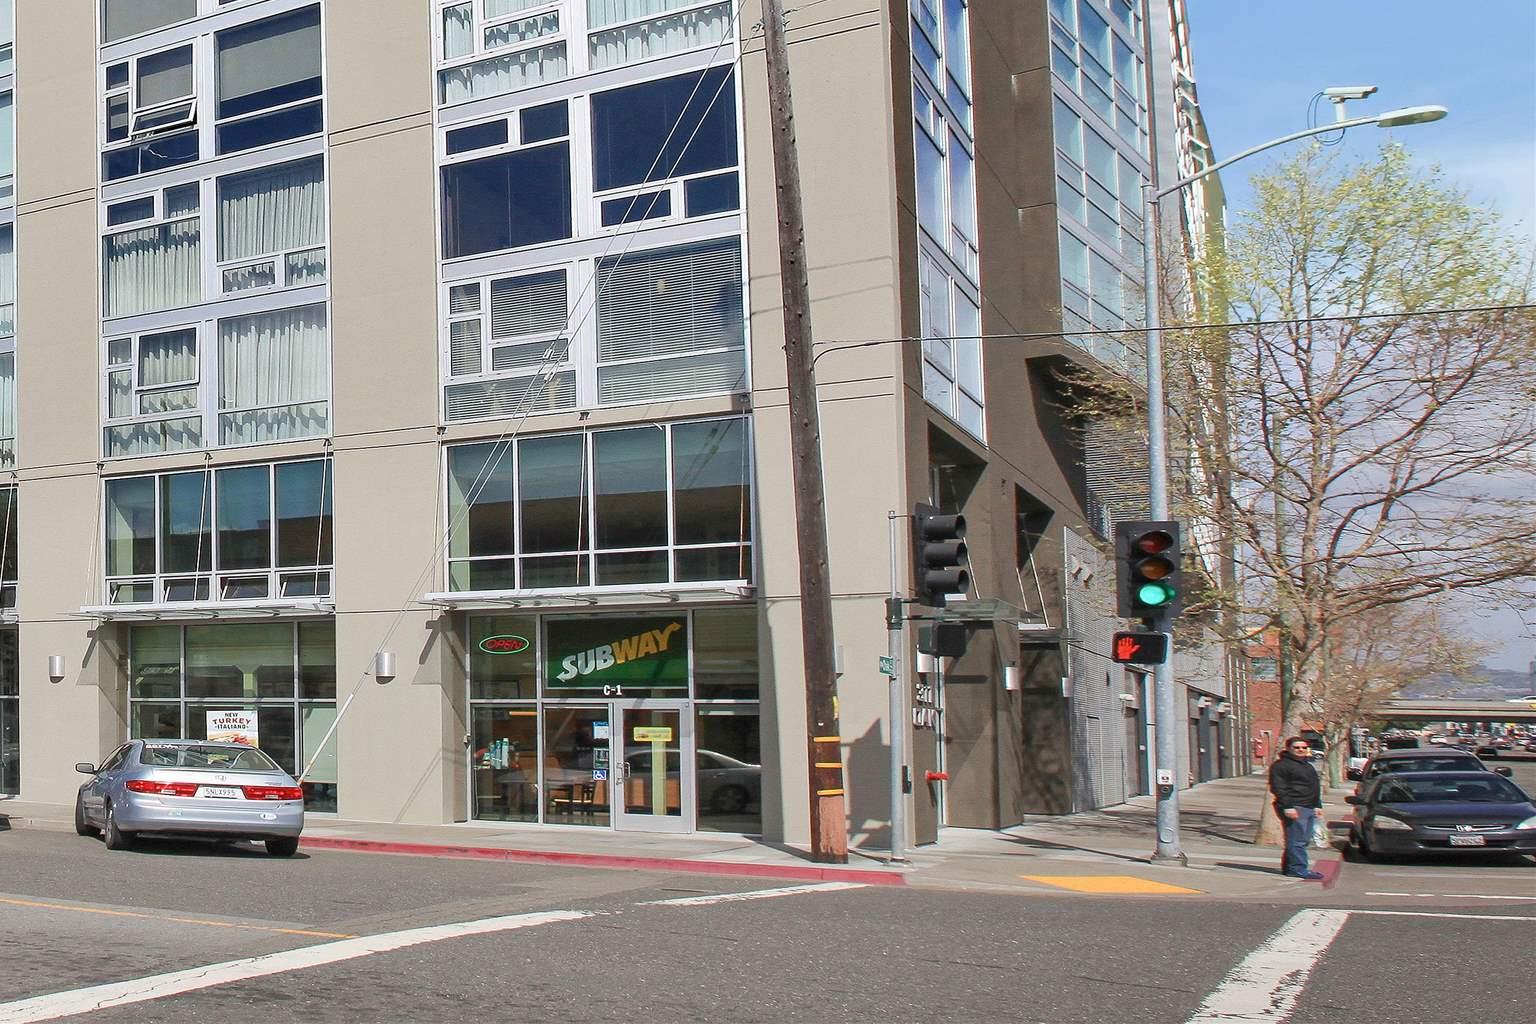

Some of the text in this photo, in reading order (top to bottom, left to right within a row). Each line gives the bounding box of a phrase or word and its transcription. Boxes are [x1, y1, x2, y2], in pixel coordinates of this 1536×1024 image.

[485, 638, 523, 650] OPEN
[556, 621, 682, 683] SUBWAY
[603, 684, 623, 696] C-1
[212, 717, 252, 725] TURKEY
